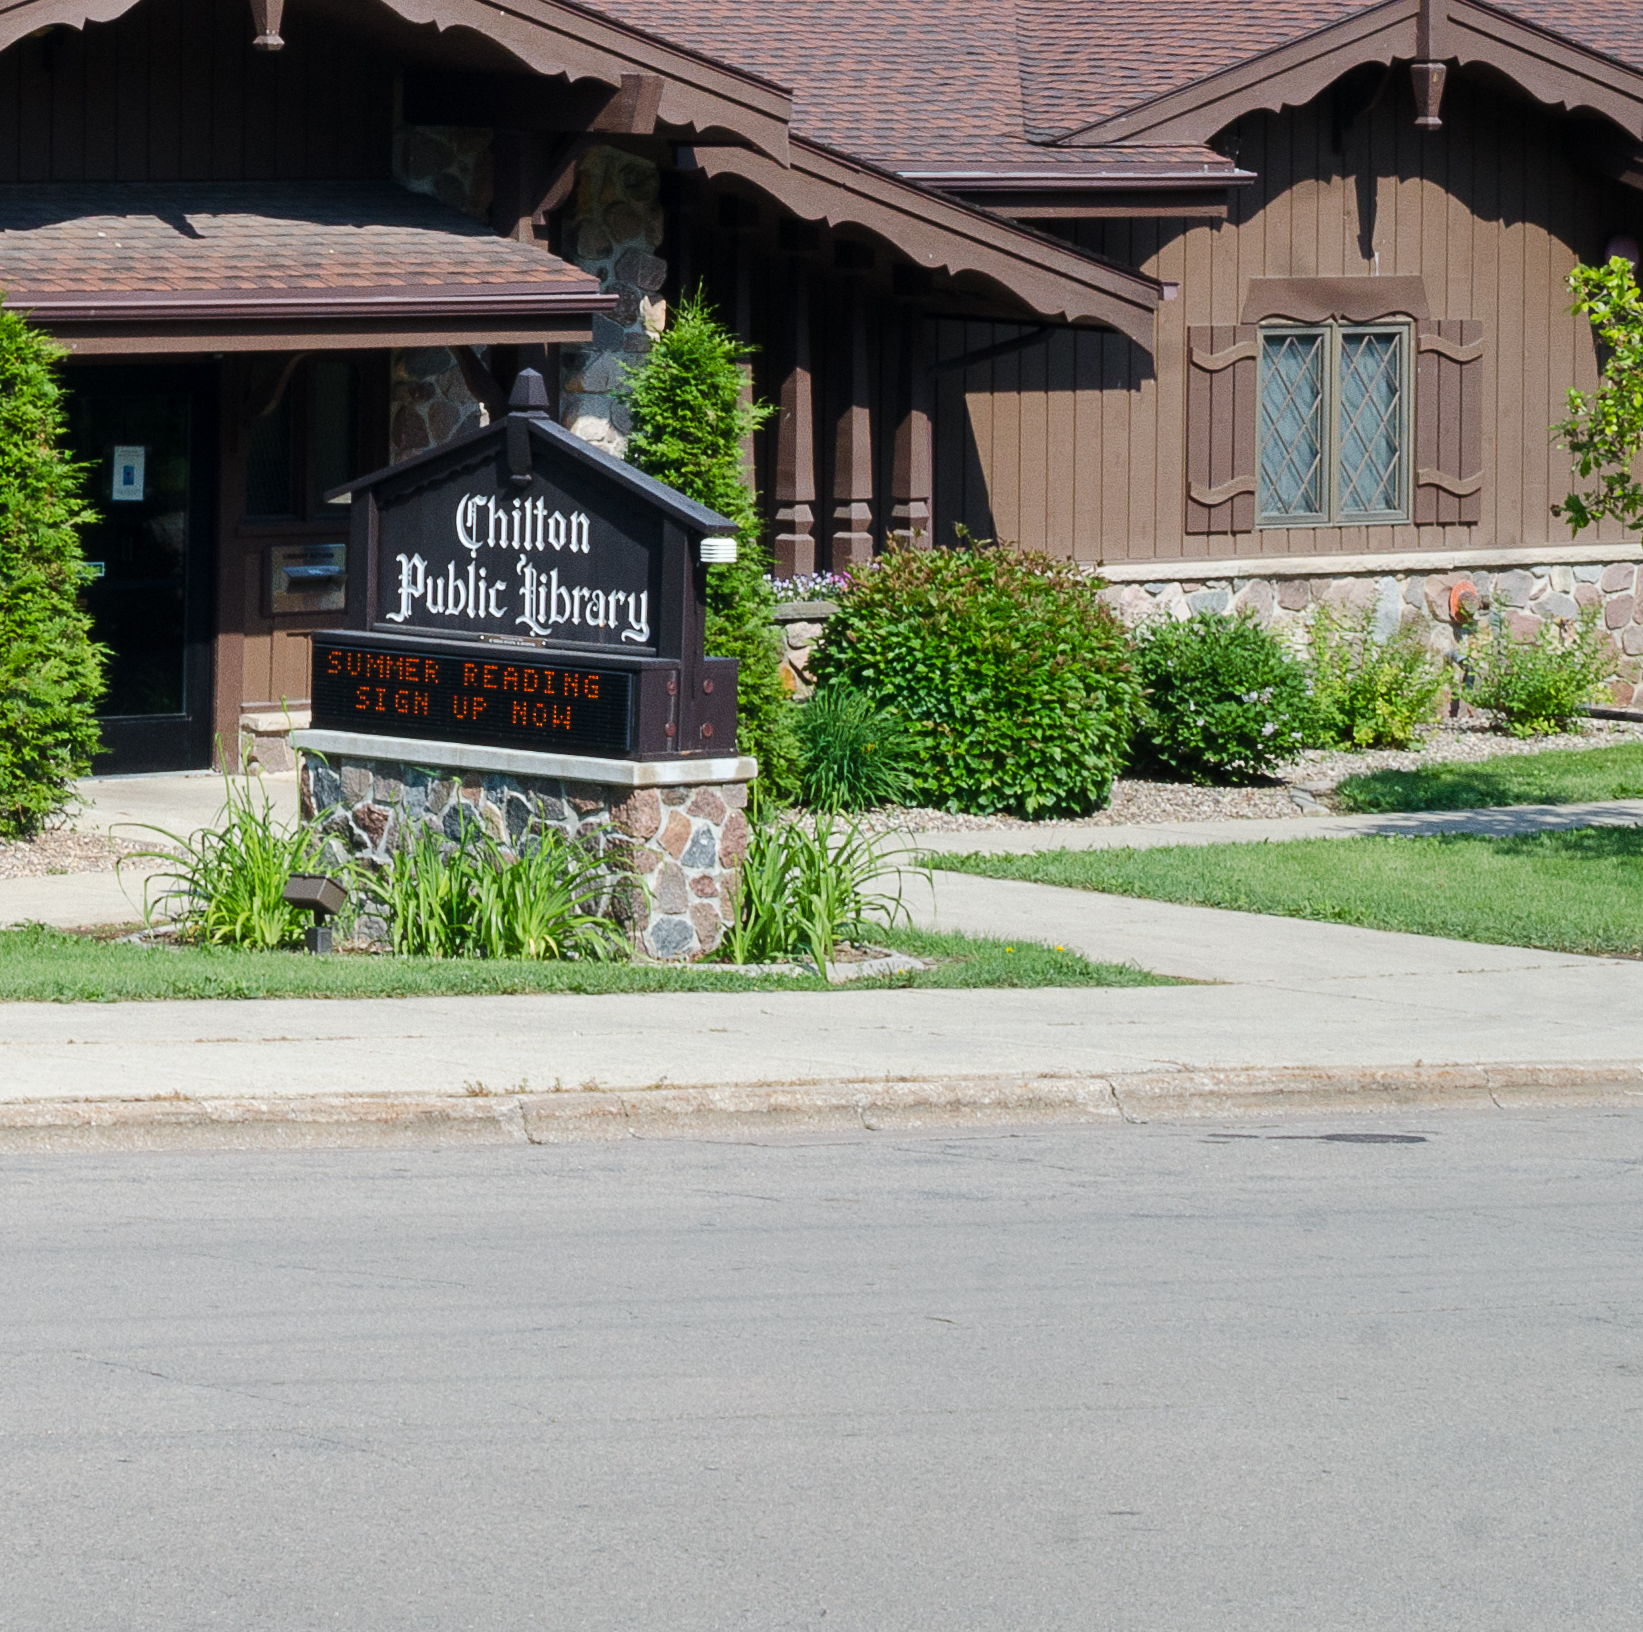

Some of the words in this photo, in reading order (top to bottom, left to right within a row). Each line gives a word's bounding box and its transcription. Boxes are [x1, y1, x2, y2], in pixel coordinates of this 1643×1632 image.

[456, 492, 590, 558] Chilton
[386, 553, 508, 623] Public
[515, 554, 651, 643] Library
[327, 651, 439, 684] SUMMER
[464, 663, 599, 699] READING
[355, 686, 428, 715] SIGN
[453, 695, 487, 720] UP
[513, 700, 571, 729] NOW
